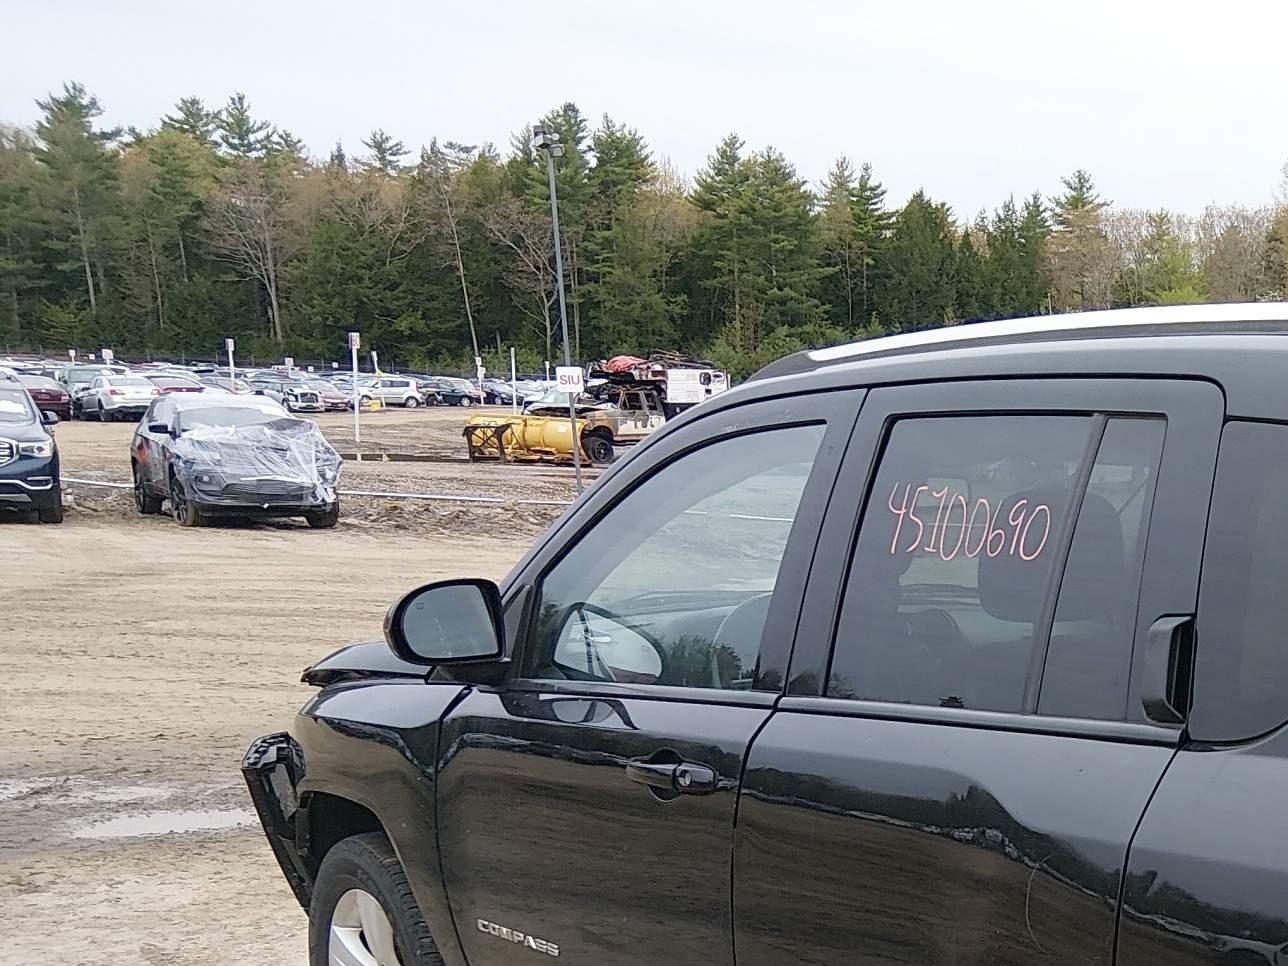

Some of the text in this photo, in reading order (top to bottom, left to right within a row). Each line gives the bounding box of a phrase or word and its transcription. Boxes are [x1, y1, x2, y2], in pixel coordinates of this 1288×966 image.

[559, 374, 581, 386] SIU
[888, 482, 1051, 561] 45100690
[476, 918, 560, 957] COMPASS
